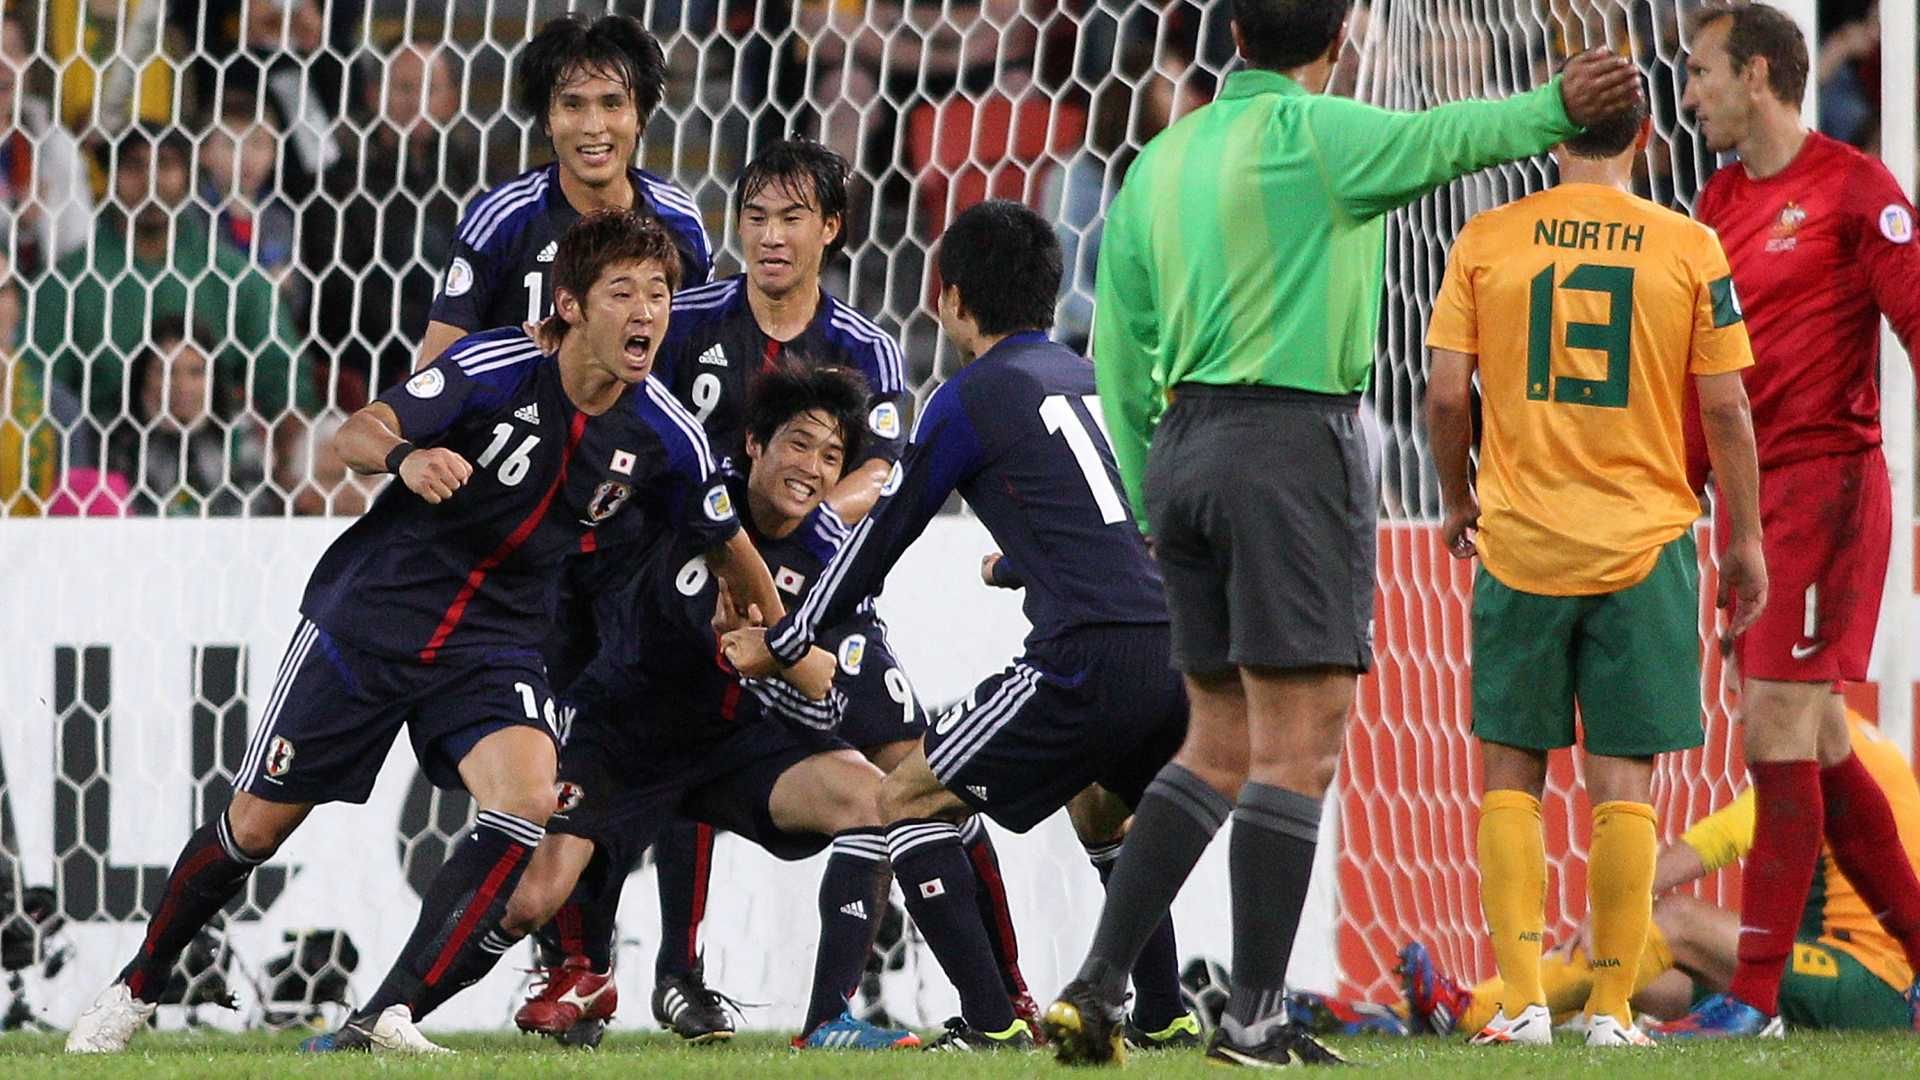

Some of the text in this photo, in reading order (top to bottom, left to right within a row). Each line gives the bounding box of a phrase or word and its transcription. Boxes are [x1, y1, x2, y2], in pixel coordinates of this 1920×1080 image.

[1534, 219, 1645, 252] NORTH
[1527, 262, 1635, 408] 13
[692, 373, 721, 424] 9
[477, 422, 541, 486] 16
[1803, 582, 1817, 638] 1
[885, 667, 914, 723] 9
